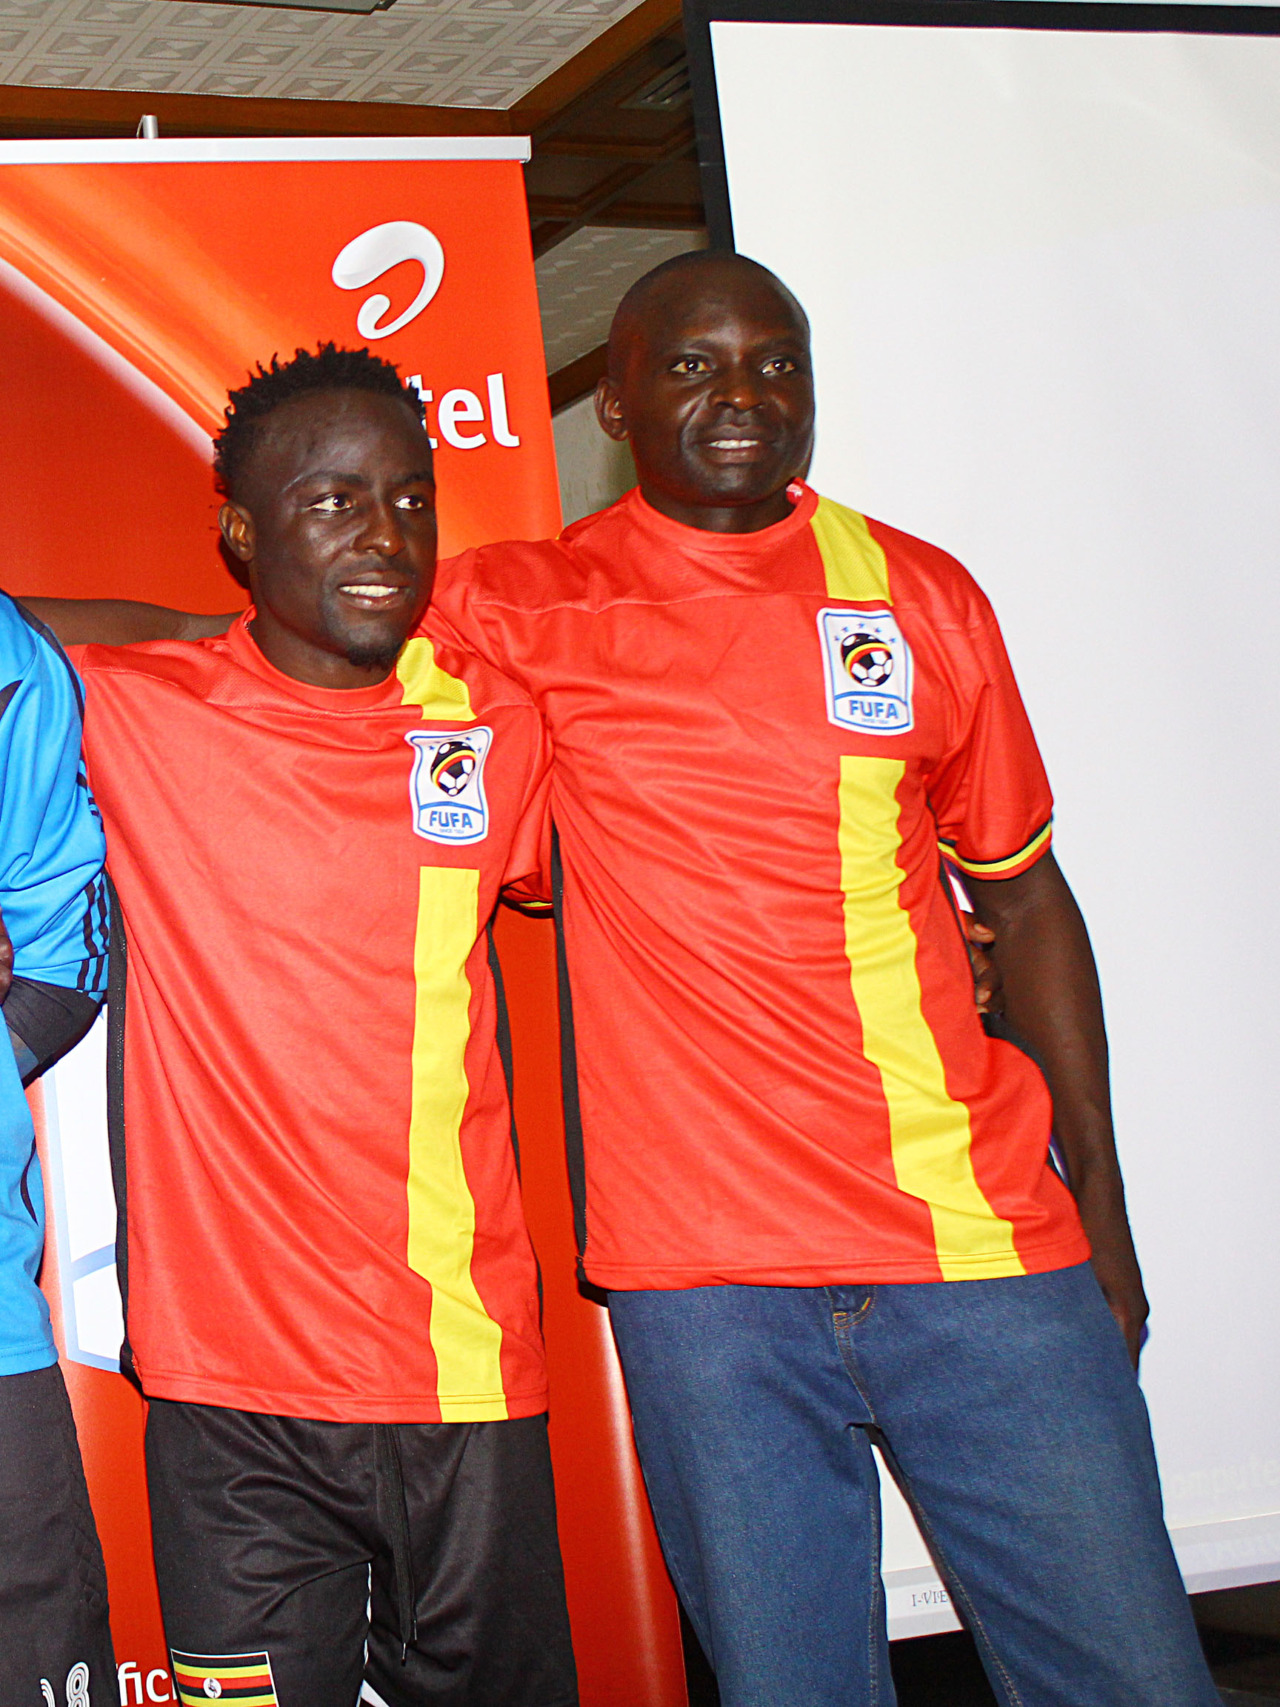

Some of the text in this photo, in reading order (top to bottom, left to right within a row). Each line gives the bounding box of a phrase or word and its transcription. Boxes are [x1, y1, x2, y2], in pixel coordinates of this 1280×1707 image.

[405, 372, 520, 449] tel
[849, 699, 899, 719] FUFA
[429, 811, 473, 828] FUFA
[911, 1589, 950, 1607] I-VIE
[116, 1661, 177, 1707] fic
